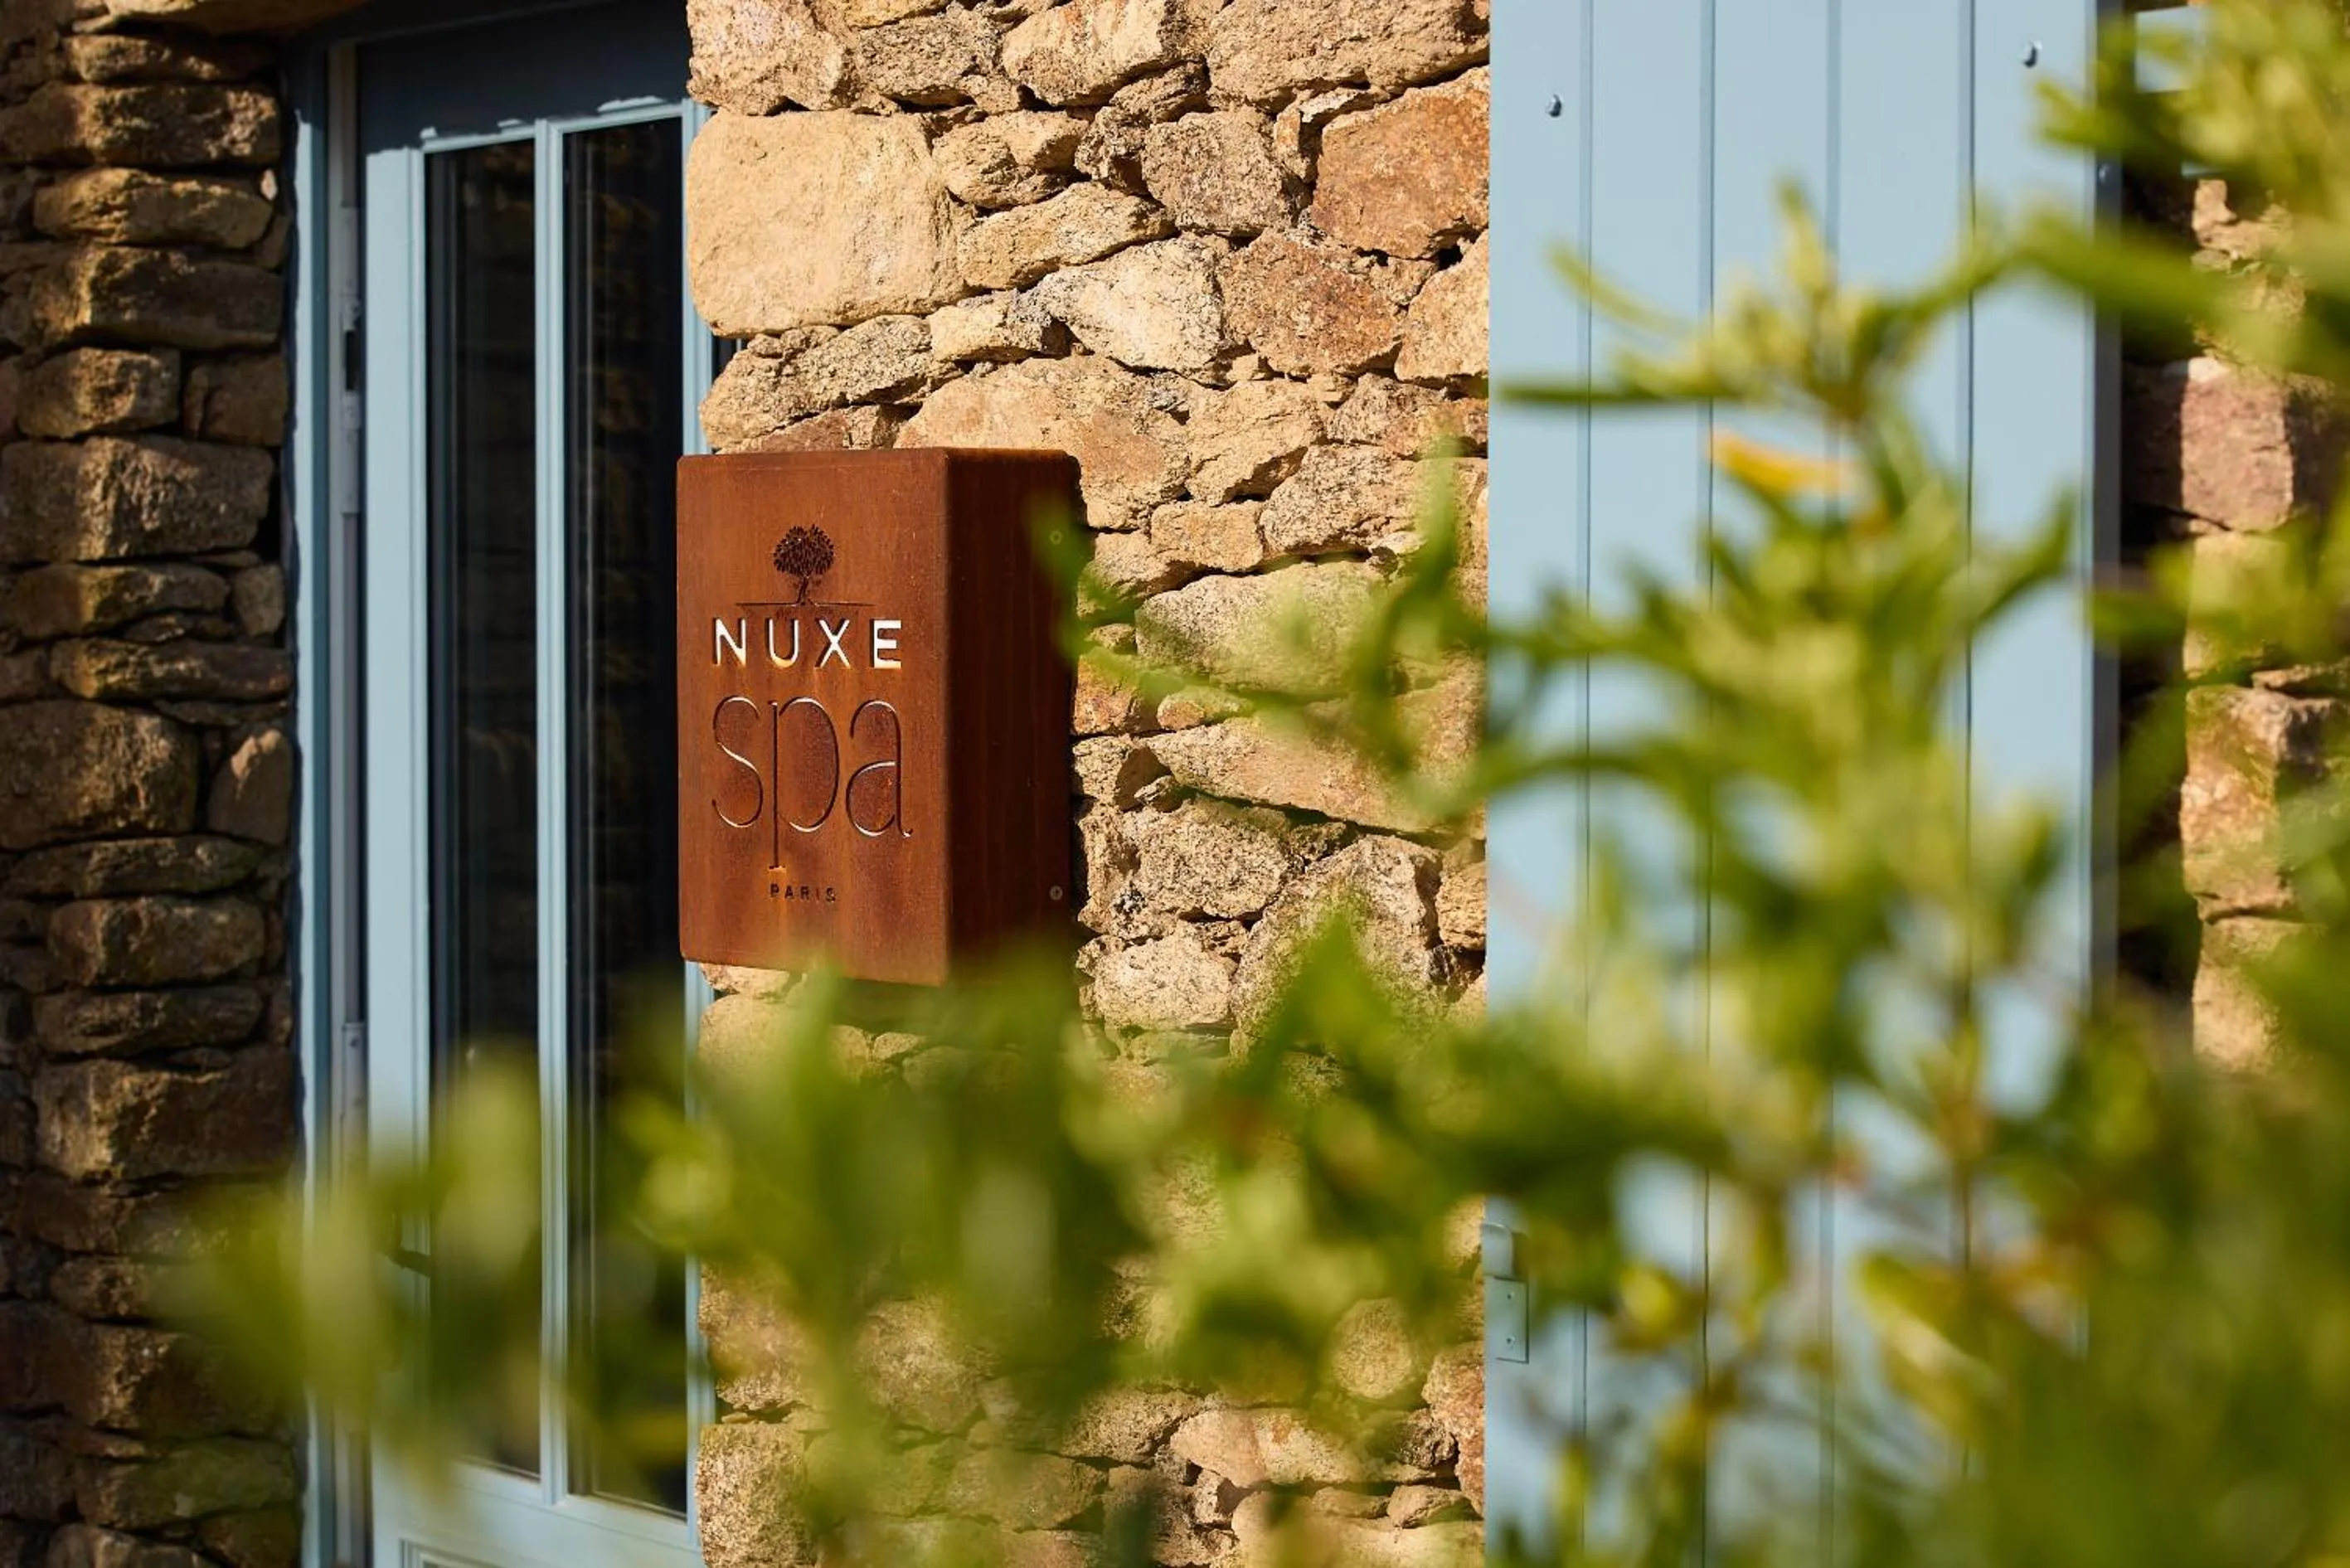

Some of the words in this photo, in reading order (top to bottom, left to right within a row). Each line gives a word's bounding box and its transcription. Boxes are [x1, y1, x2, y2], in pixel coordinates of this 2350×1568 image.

[712, 617, 902, 670] NUXE
[711, 695, 914, 871] spa
[770, 883, 837, 903] PARIS
